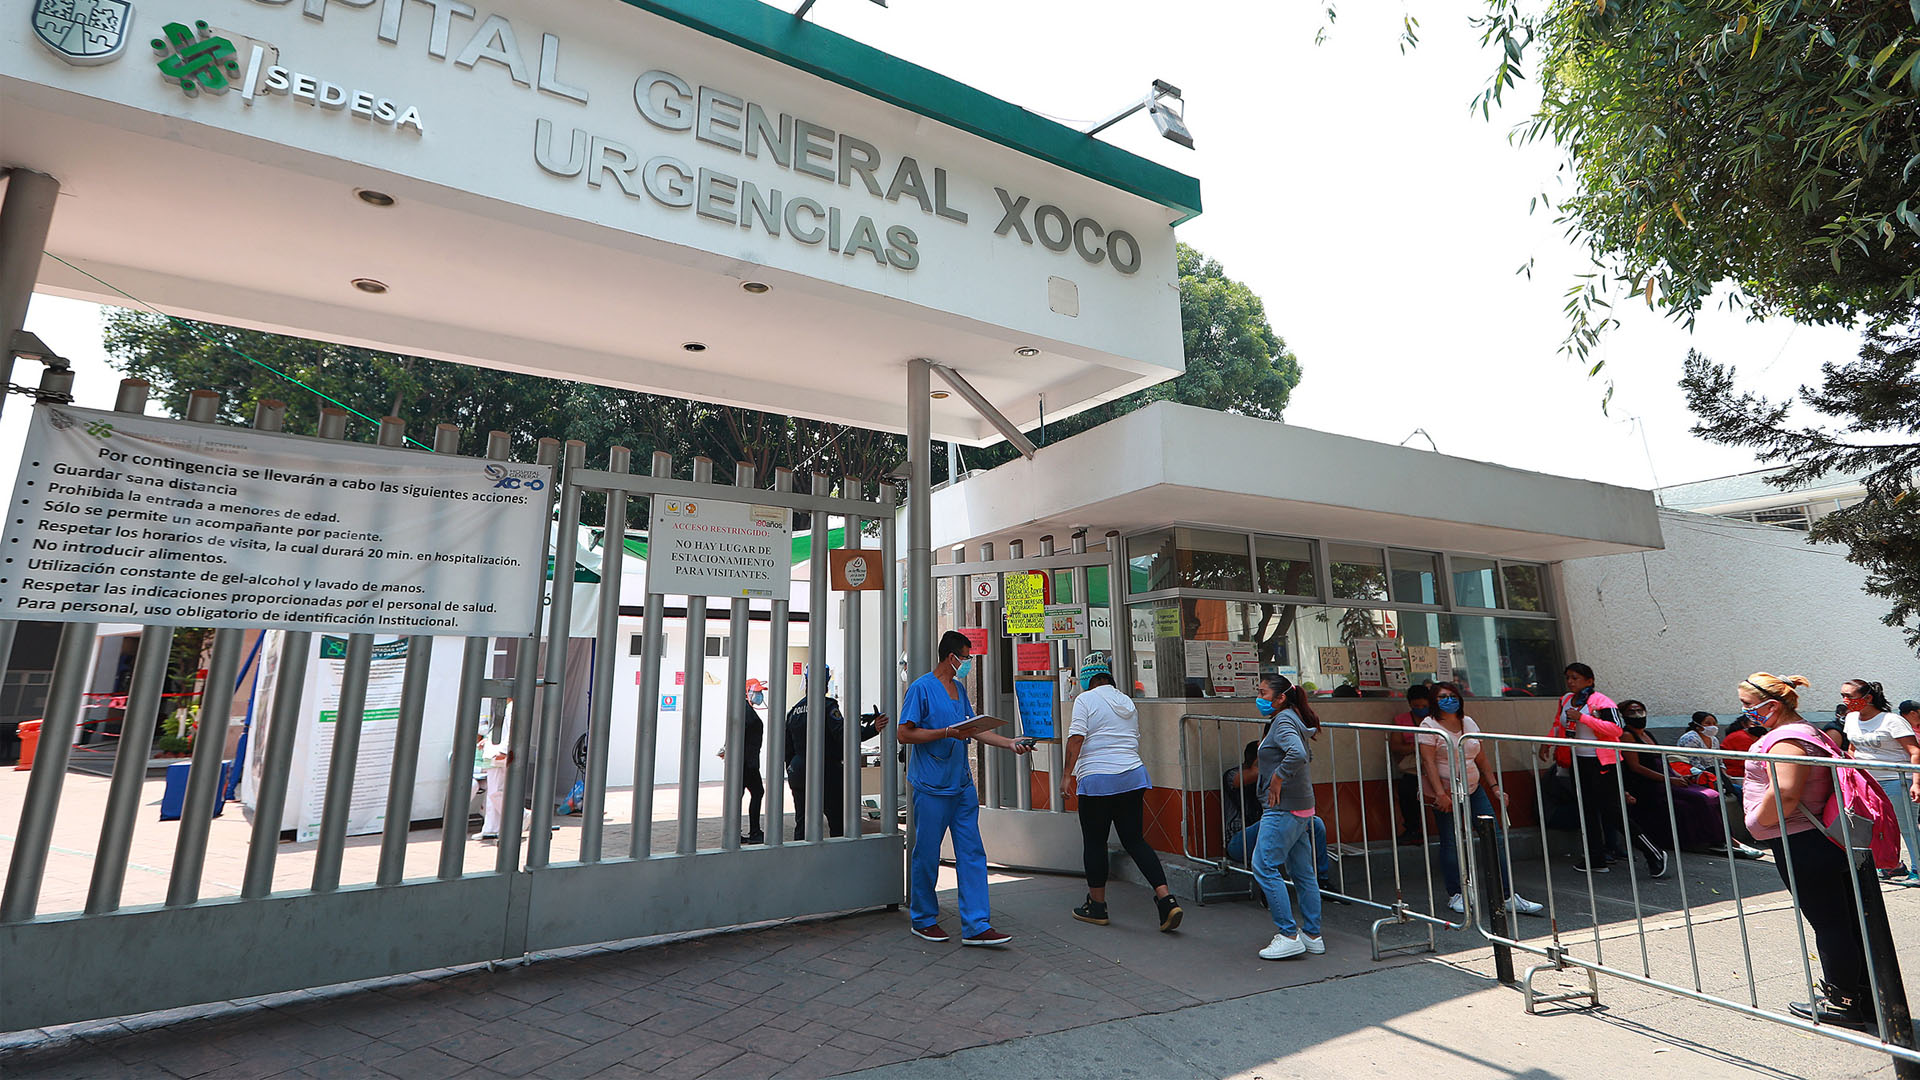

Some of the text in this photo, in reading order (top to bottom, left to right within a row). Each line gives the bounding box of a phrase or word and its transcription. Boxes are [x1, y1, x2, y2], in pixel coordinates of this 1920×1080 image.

[264, 65, 424, 137] SEDESA
[634, 69, 968, 224] GENERAL
[993, 187, 1142, 275] XOCO
[535, 118, 920, 271] URGENCIAS
[53, 462, 238, 496] Guardar sana distancia
[98, 448, 528, 504] Por contingencia se llevarán a cabo las siguientes acciones:
[43, 499, 383, 541] Sólo se permite un acompañante por paciente.
[48, 482, 340, 523] Prohibida la entrada a menores de edad.
[38, 519, 521, 567] Respetar los horarios de visita, la cual durará 20 min. en hospitalización.
[673, 522, 770, 537] ACCESO RESTRINGIDO:
[676, 540, 771, 554] NO HAY LUGAR DE
[33, 539, 227, 564] No introducir alimentos.
[672, 553, 774, 567] ESTACIONAMIENTO
[28, 558, 425, 593] Utilización constante de gel-alcohol y lavado de manos.
[676, 566, 770, 580] PARA VISITANTES.
[17, 597, 458, 628] Para personal, uso obligatorio de identificación Institucional.
[22, 578, 497, 614] Respetar las indicaciones proporcionadas por el personal de salud.
[793, 705, 808, 715] POLIC
